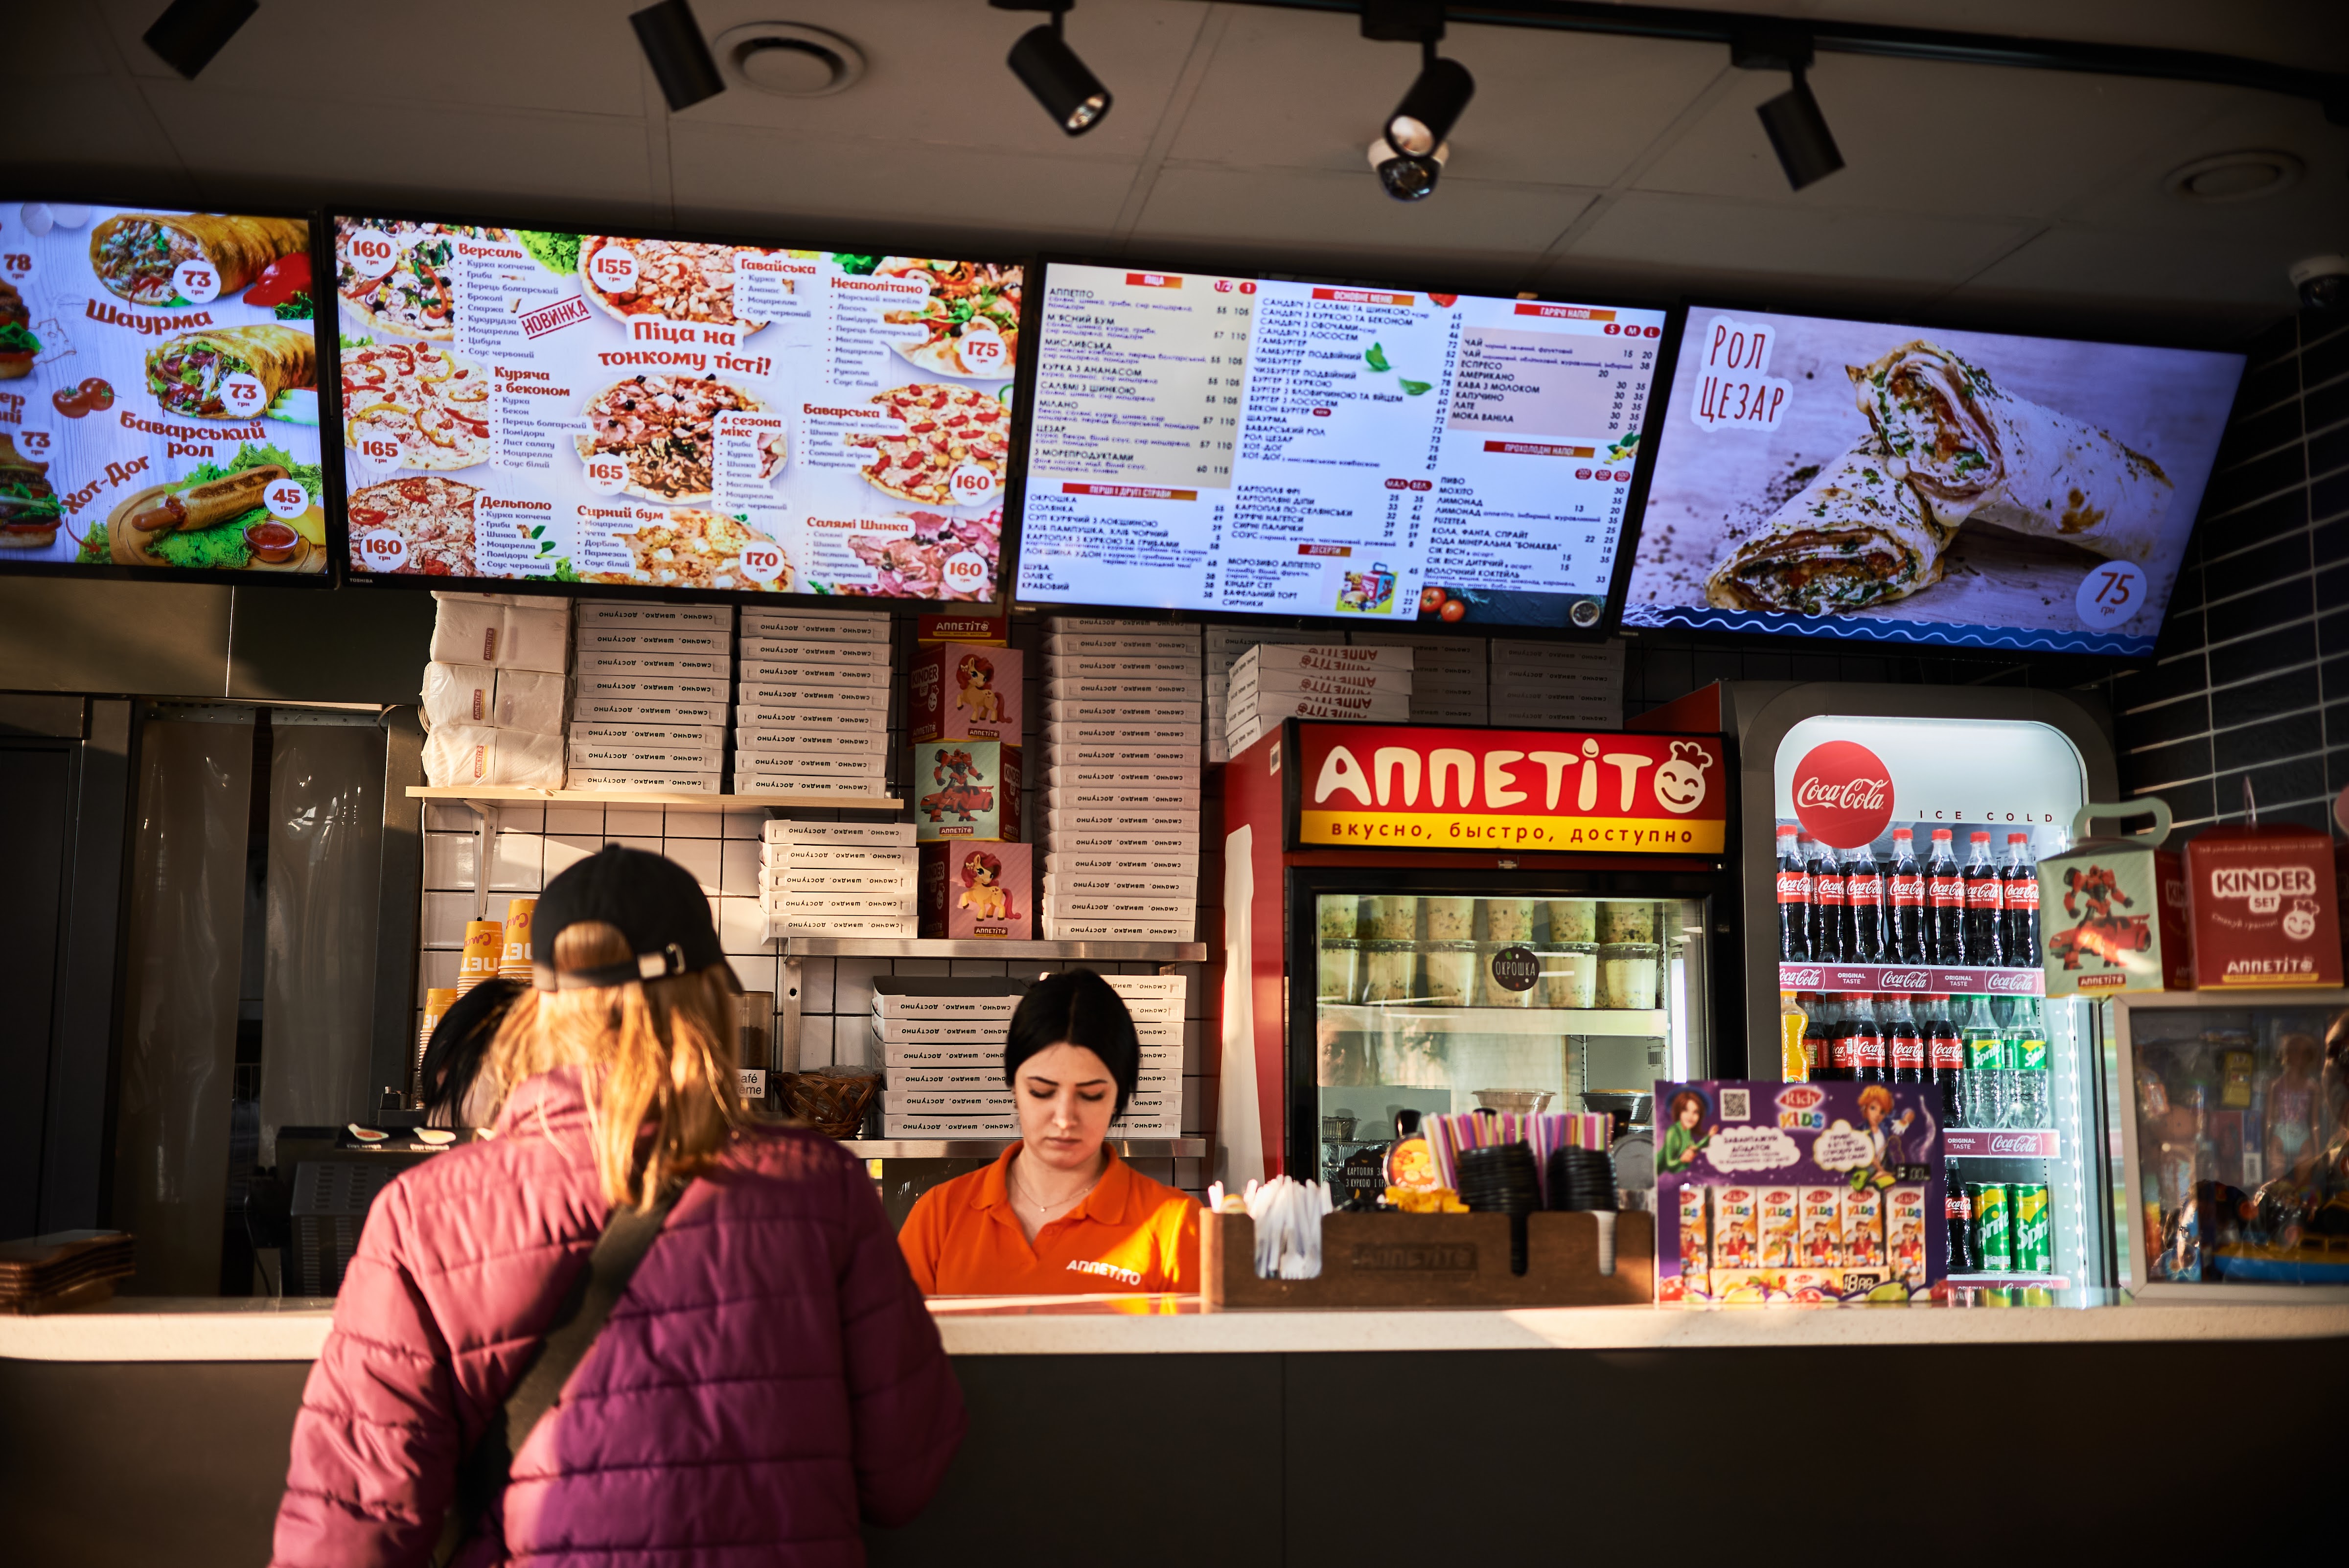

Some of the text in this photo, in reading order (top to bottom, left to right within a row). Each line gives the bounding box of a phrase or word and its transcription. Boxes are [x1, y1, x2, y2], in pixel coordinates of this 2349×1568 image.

[353, 241, 391, 259] 160
[458, 243, 522, 259] Версаль
[4, 254, 31, 271] 78
[466, 260, 535, 272] Курка копчена
[597, 259, 631, 275] 155
[741, 259, 816, 275] Гавайська
[183, 271, 211, 288] 73
[467, 270, 492, 280] Гриби
[467, 282, 558, 295] Перець болгарський
[831, 277, 922, 294] Неаполітано
[468, 293, 503, 301] Броколі
[468, 303, 504, 314] Спаржа
[86, 299, 213, 335] Шаурма
[468, 315, 516, 326] Кукурудза
[521, 300, 590, 335] НОВИНКА
[468, 326, 519, 336] Моцарелла
[635, 321, 735, 346] Піца на
[468, 337, 501, 347] Цибуля
[1465, 339, 1482, 347] ЧАЙ
[1710, 325, 1765, 369] РОЛ
[468, 348, 534, 359] Соус червоний
[968, 342, 999, 358] 175
[598, 350, 771, 376] тонкому тісті!
[1461, 361, 1502, 370] ЕСПРЕСО
[494, 366, 550, 382] Куряча
[1459, 371, 1515, 381] АМЕРИКАНО
[229, 384, 256, 399] 73
[494, 381, 571, 397] з беконом
[1457, 381, 1481, 390] КАВА
[1491, 383, 1540, 393] МОЛОКОМ
[503, 396, 530, 406] Курка
[1456, 392, 1504, 402] КАПУЧИНО
[1700, 376, 1784, 423] ЦЕЗАР
[503, 407, 529, 416] Бекон
[803, 404, 880, 419] Баварська
[1452, 412, 1479, 420] МОКА
[120, 411, 267, 442] Баварський
[503, 417, 586, 430] Перець болгарский
[732, 416, 782, 428] сезона
[22, 432, 50, 447] 73
[503, 429, 545, 439] Помідори
[720, 426, 752, 438] мікс
[167, 442, 213, 458] рол
[363, 441, 398, 457] 165
[525, 440, 555, 449] салату
[589, 464, 623, 479] 165
[61, 455, 149, 515] Хот-Дог
[956, 475, 989, 490] 160
[273, 489, 300, 504] 45
[481, 496, 552, 511] Дельполо
[577, 505, 664, 522] Сирний бум
[806, 517, 909, 532] Салямі Шинка
[486, 530, 516, 539] Шинка
[367, 539, 402, 554] 160
[585, 549, 627, 558] Пармезан
[487, 551, 528, 560] Помідори
[746, 552, 778, 567] 170
[487, 560, 550, 571] Соус червоний
[949, 561, 982, 576] 160
[2095, 572, 2134, 605] 75
[2101, 606, 2115, 616] грн
[912, 665, 938, 685] KINDER
[1797, 777, 1889, 809] Coca-Cola
[1920, 810, 2052, 822] ICE COLD
[1332, 822, 1692, 846] вкусно, быстро, доступно
[2217, 871, 2311, 893] KINDER
[2255, 898, 2276, 908] SET
[1496, 960, 1535, 977] ОКРОШКА
[1881, 971, 1927, 989] Coca-Cola
[1988, 973, 2033, 991] Coca-Cola
[1973, 1044, 2001, 1066] Sprite
[738, 1074, 757, 1083] afé
[1991, 1135, 2037, 1153] Coca-Cola
[1347, 1167, 1374, 1176] КАРТОПЛЯ
[1351, 1179, 1370, 1187] КУРКОЮ
